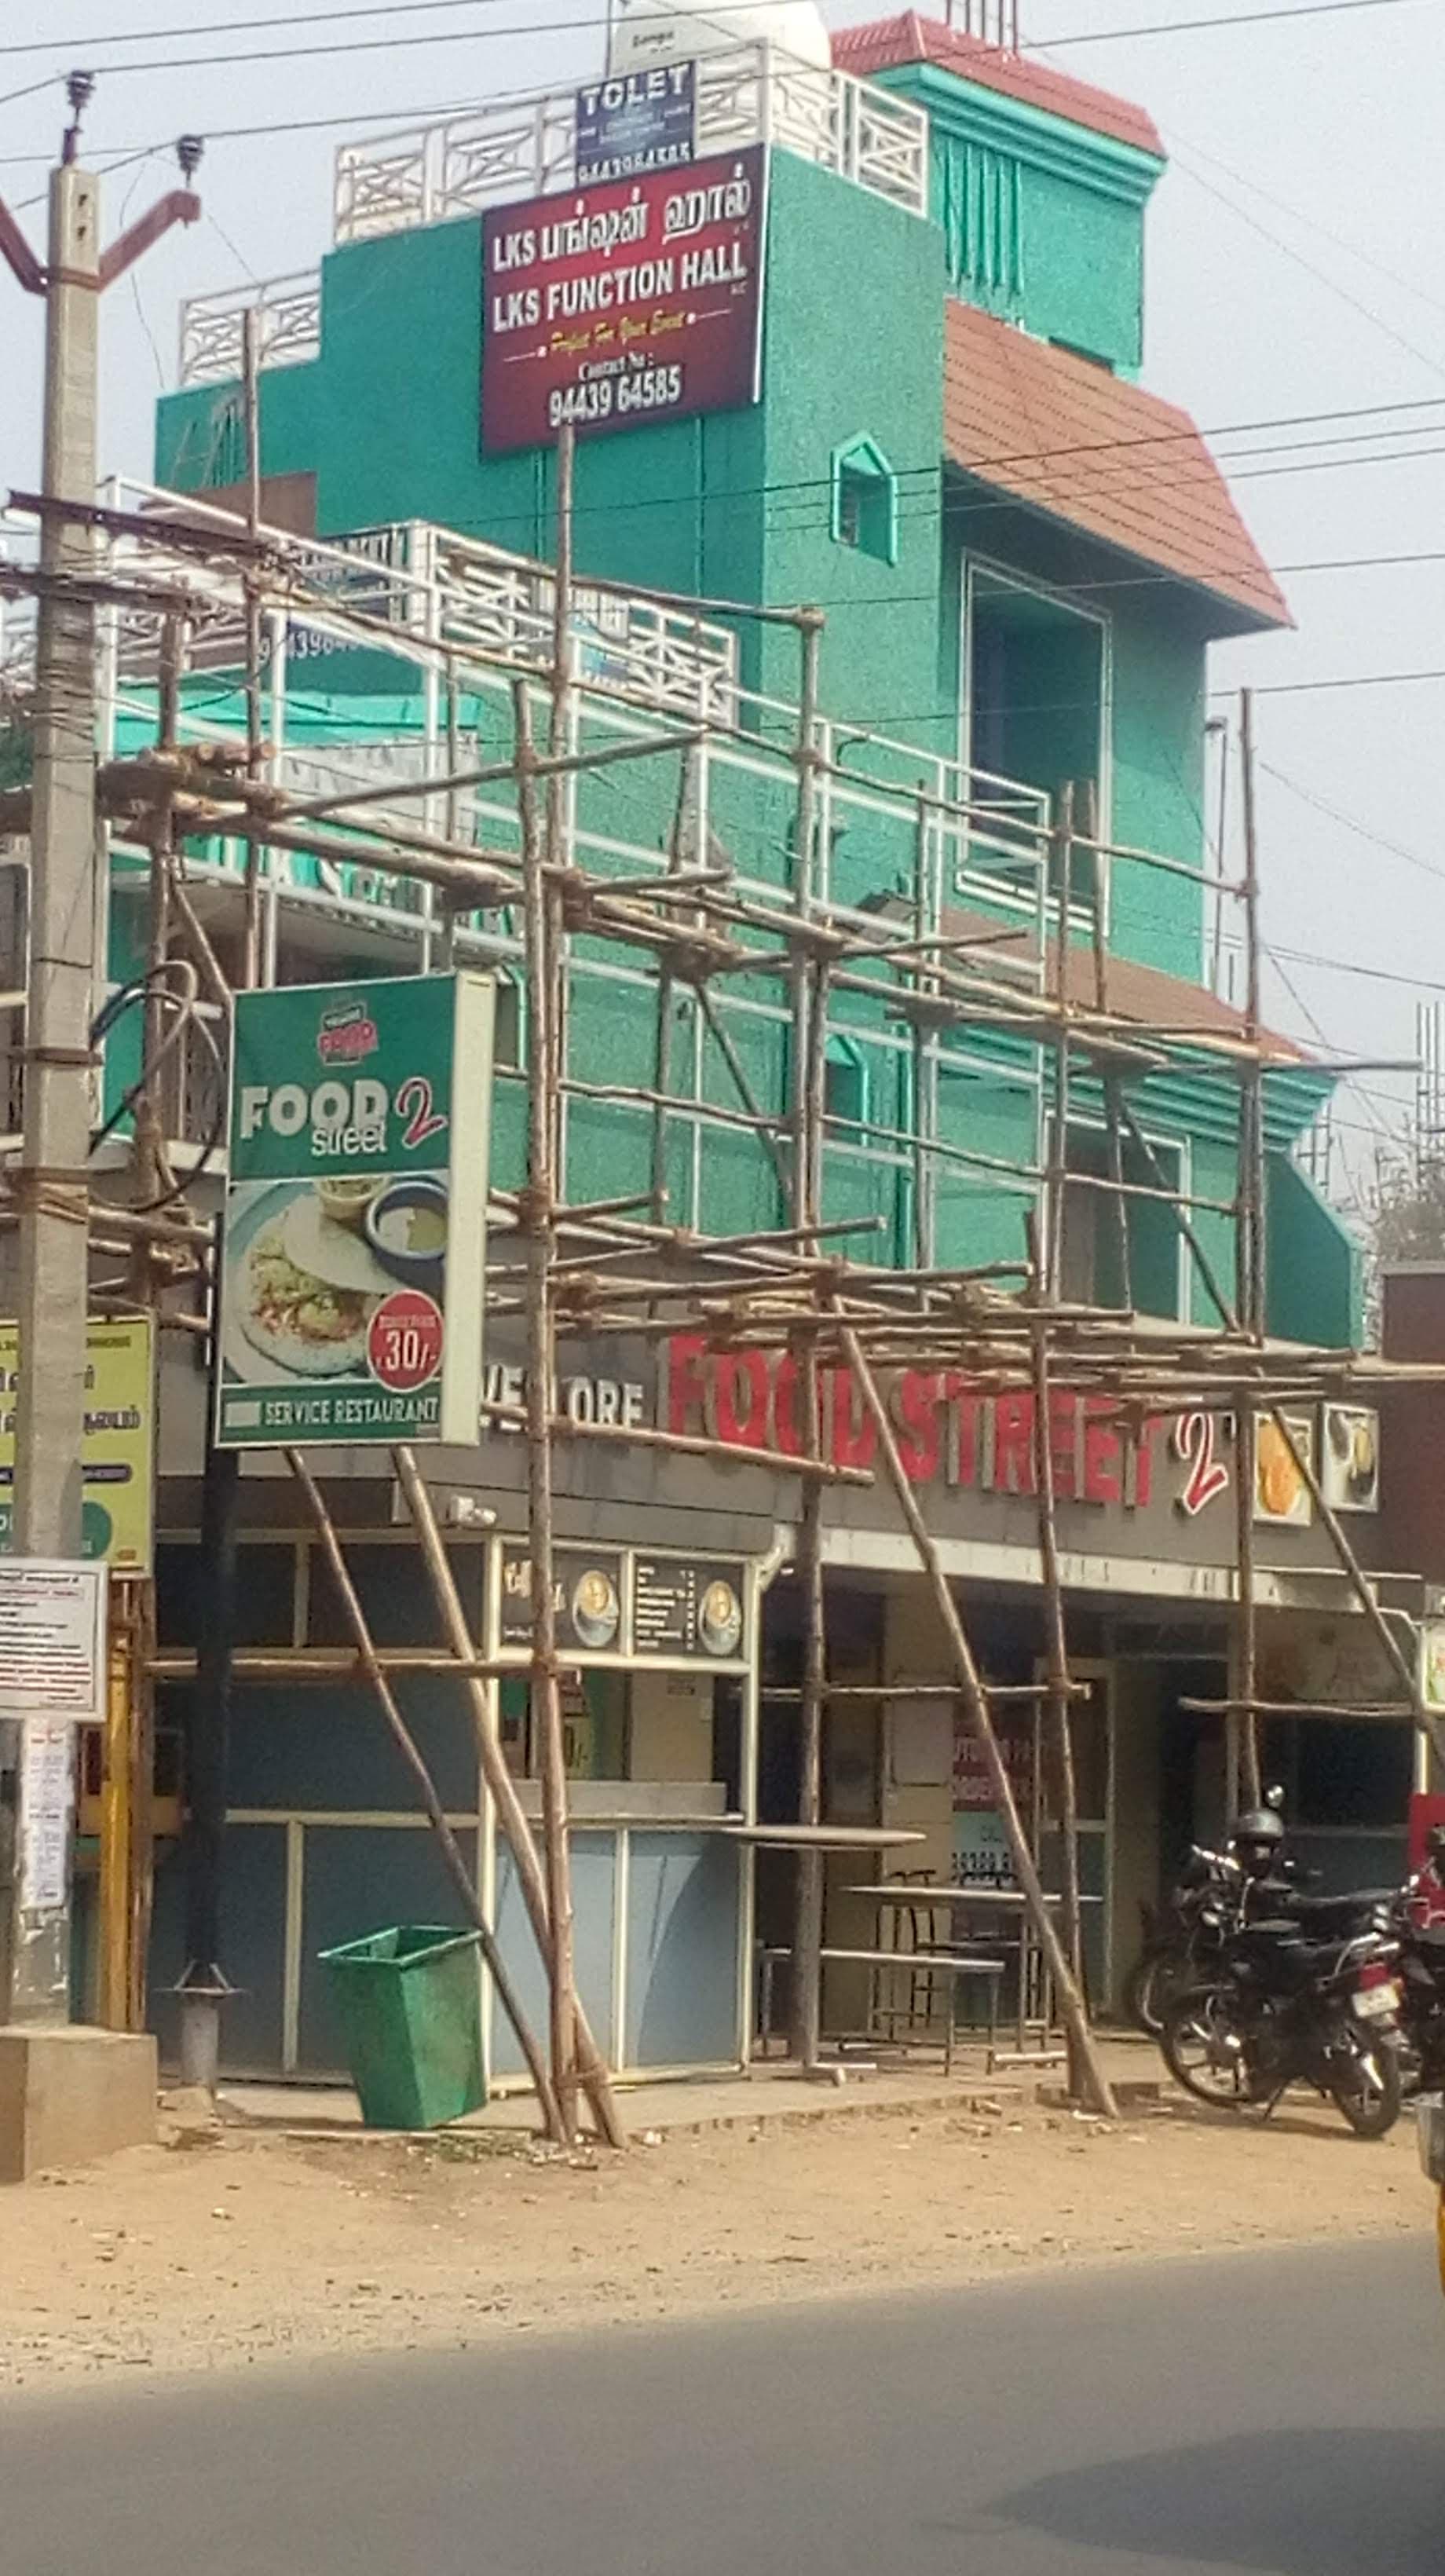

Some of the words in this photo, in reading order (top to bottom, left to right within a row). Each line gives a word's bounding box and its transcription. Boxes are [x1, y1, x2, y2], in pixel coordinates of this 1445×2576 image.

[493, 229, 536, 272] LKS
[662, 163, 752, 245] ஹால்
[493, 288, 540, 332] LKS
[547, 258, 674, 320] FUNCTION
[681, 243, 747, 290] HALL
[551, 375, 611, 426] 94439
[618, 364, 681, 412] 64585
[240, 1079, 389, 1140] FOOD
[397, 1077, 447, 1149] 2
[265, 1400, 330, 1425] SERVICE
[334, 1397, 438, 1423] RESTAURANT
[1175, 1412, 1230, 1516] 2
